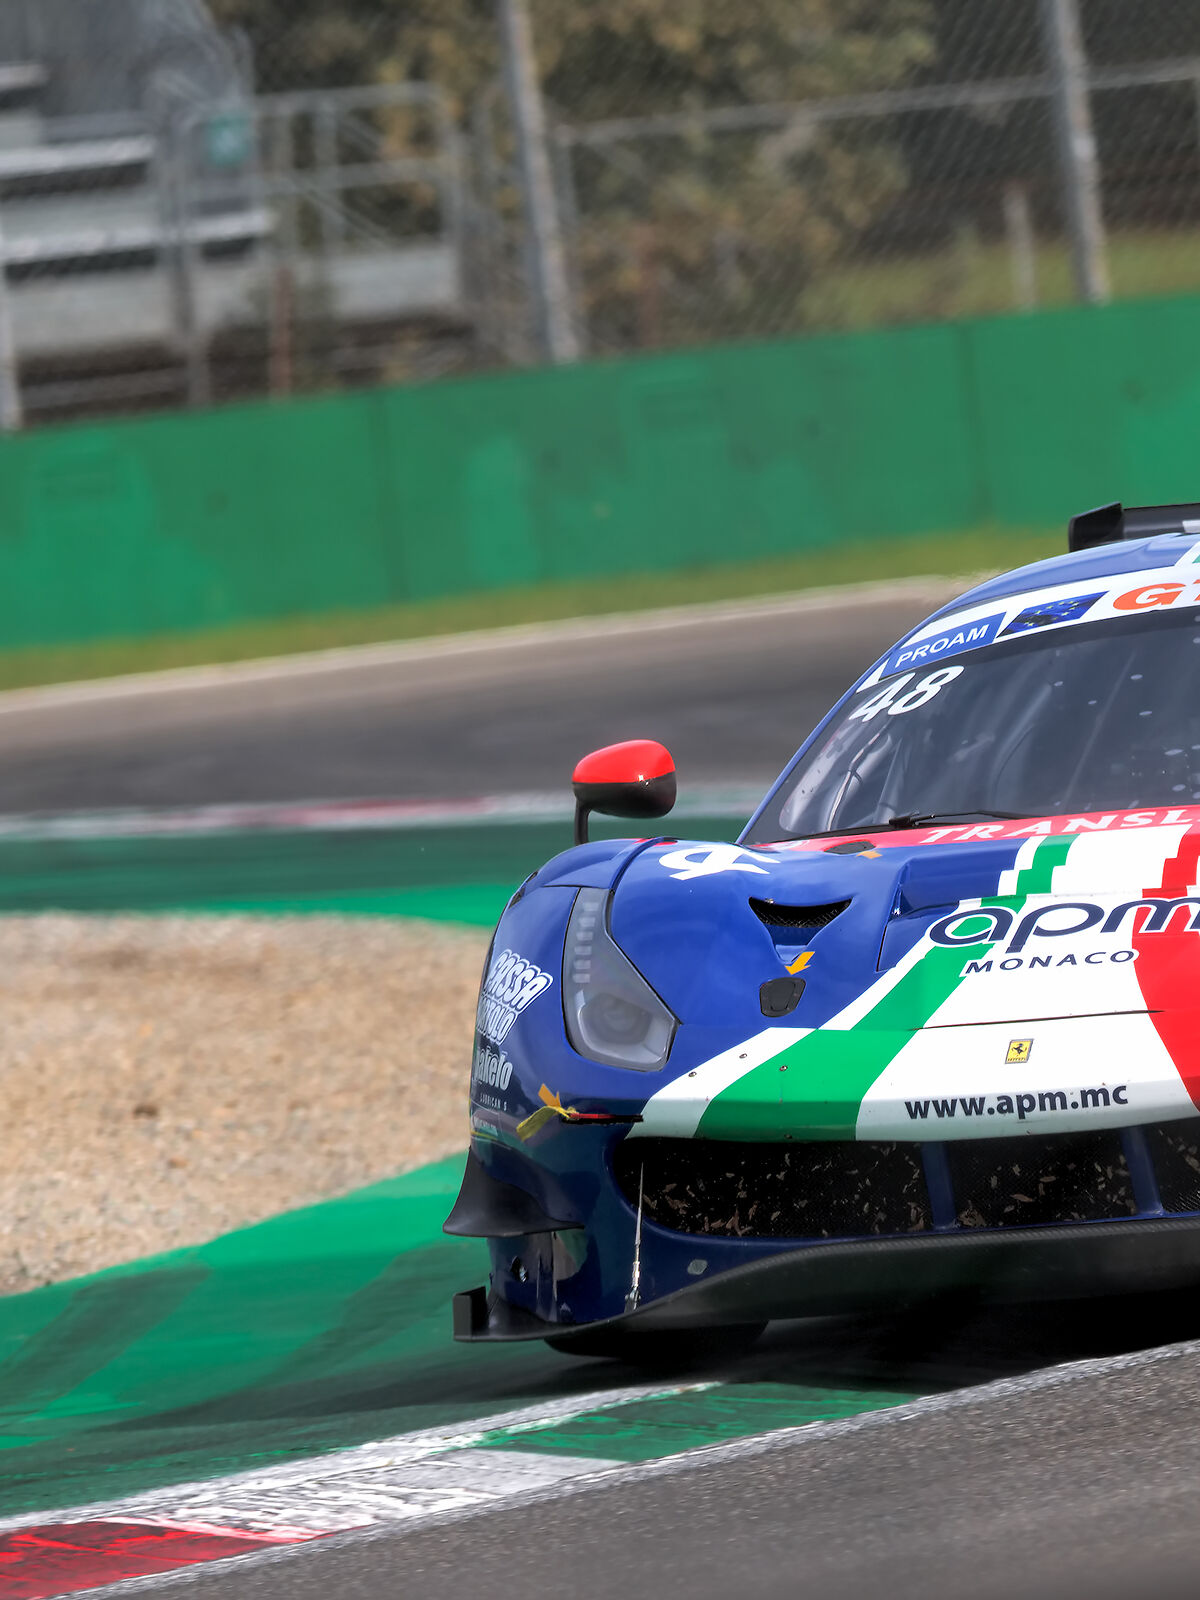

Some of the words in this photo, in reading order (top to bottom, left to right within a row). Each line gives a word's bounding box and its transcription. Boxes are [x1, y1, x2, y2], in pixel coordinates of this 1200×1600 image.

[895, 623, 989, 667] PROAM
[848, 665, 965, 723] 48
[964, 949, 1137, 975] MONACO
[904, 1083, 1130, 1121] www.apm.mc
